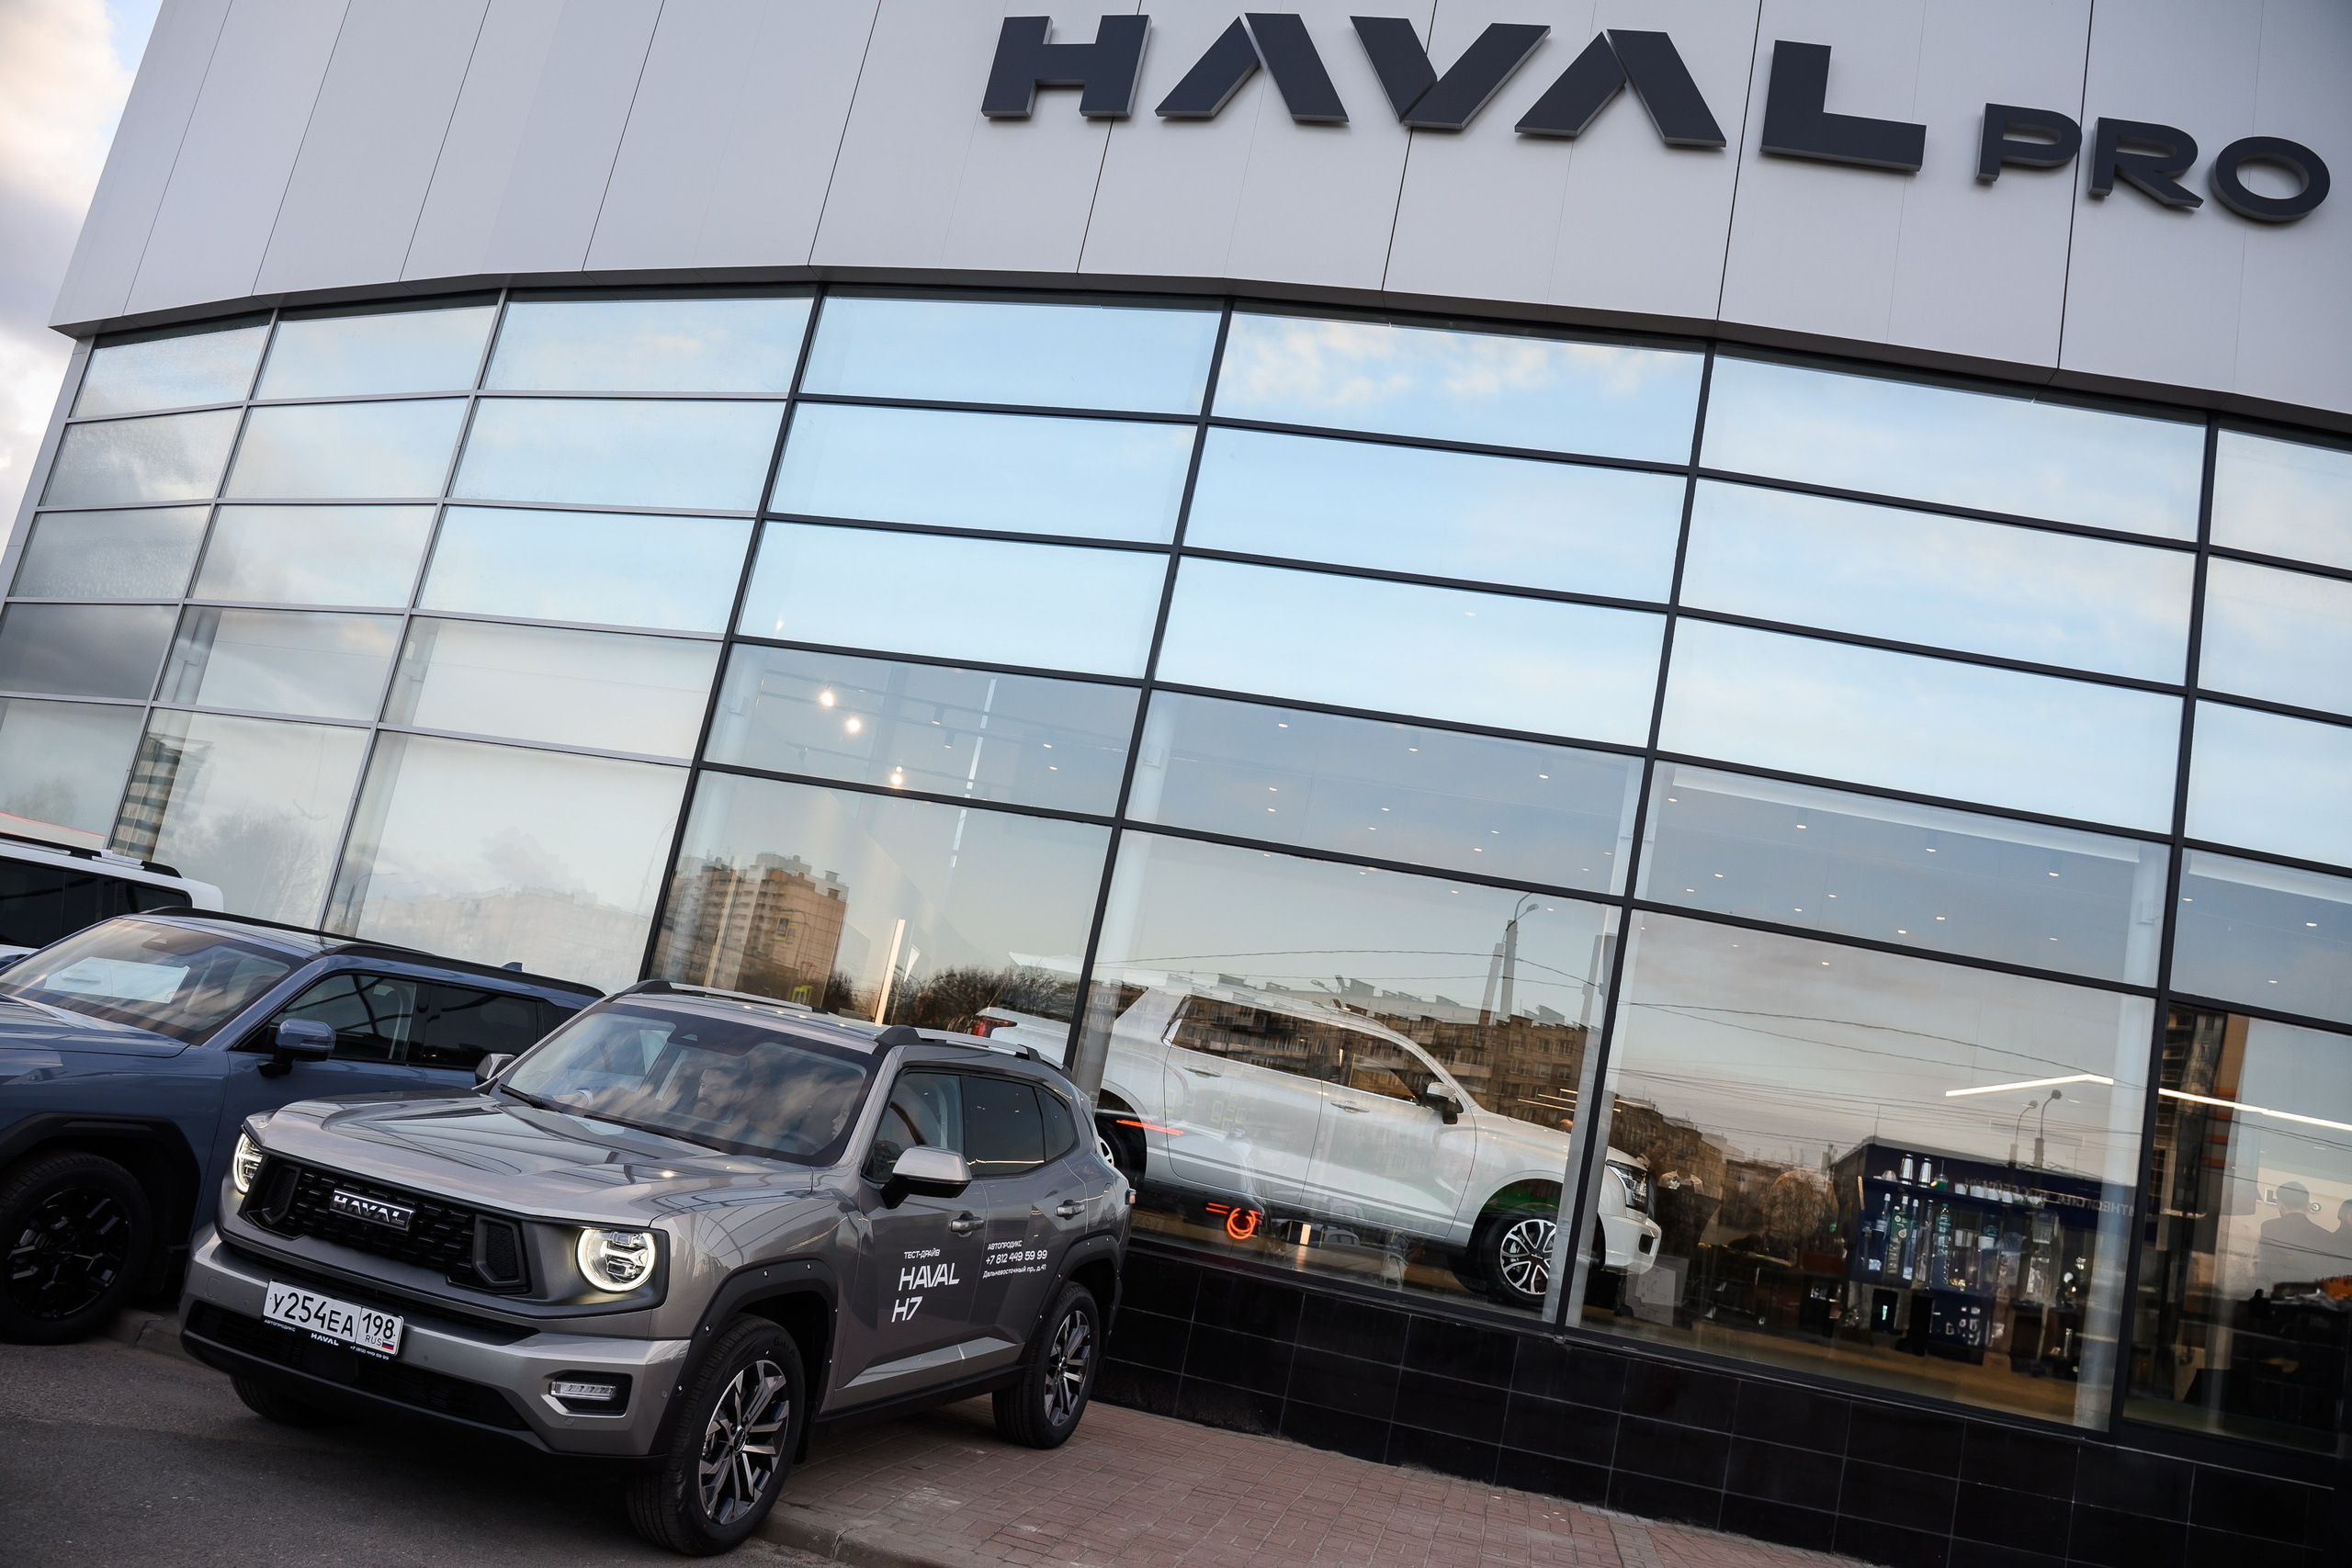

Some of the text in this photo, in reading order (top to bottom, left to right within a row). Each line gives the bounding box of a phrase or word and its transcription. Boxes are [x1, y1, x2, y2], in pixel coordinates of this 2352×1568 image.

[981, 12, 2332, 224] HAVAL PRO
[333, 1195, 405, 1224] HAVAL
[904, 1248, 941, 1259] ТЕСТ-ДРАЙВ
[987, 1240, 1023, 1250] АВТОПРОДИКС
[986, 1249, 1047, 1265] +7 812 449 59 99
[898, 1262, 961, 1292] HAVAL
[890, 1296, 922, 1323] H7
[362, 1312, 395, 1339] 198
[311, 1332, 339, 1347] HAVAL
[365, 1334, 381, 1347] RUS
